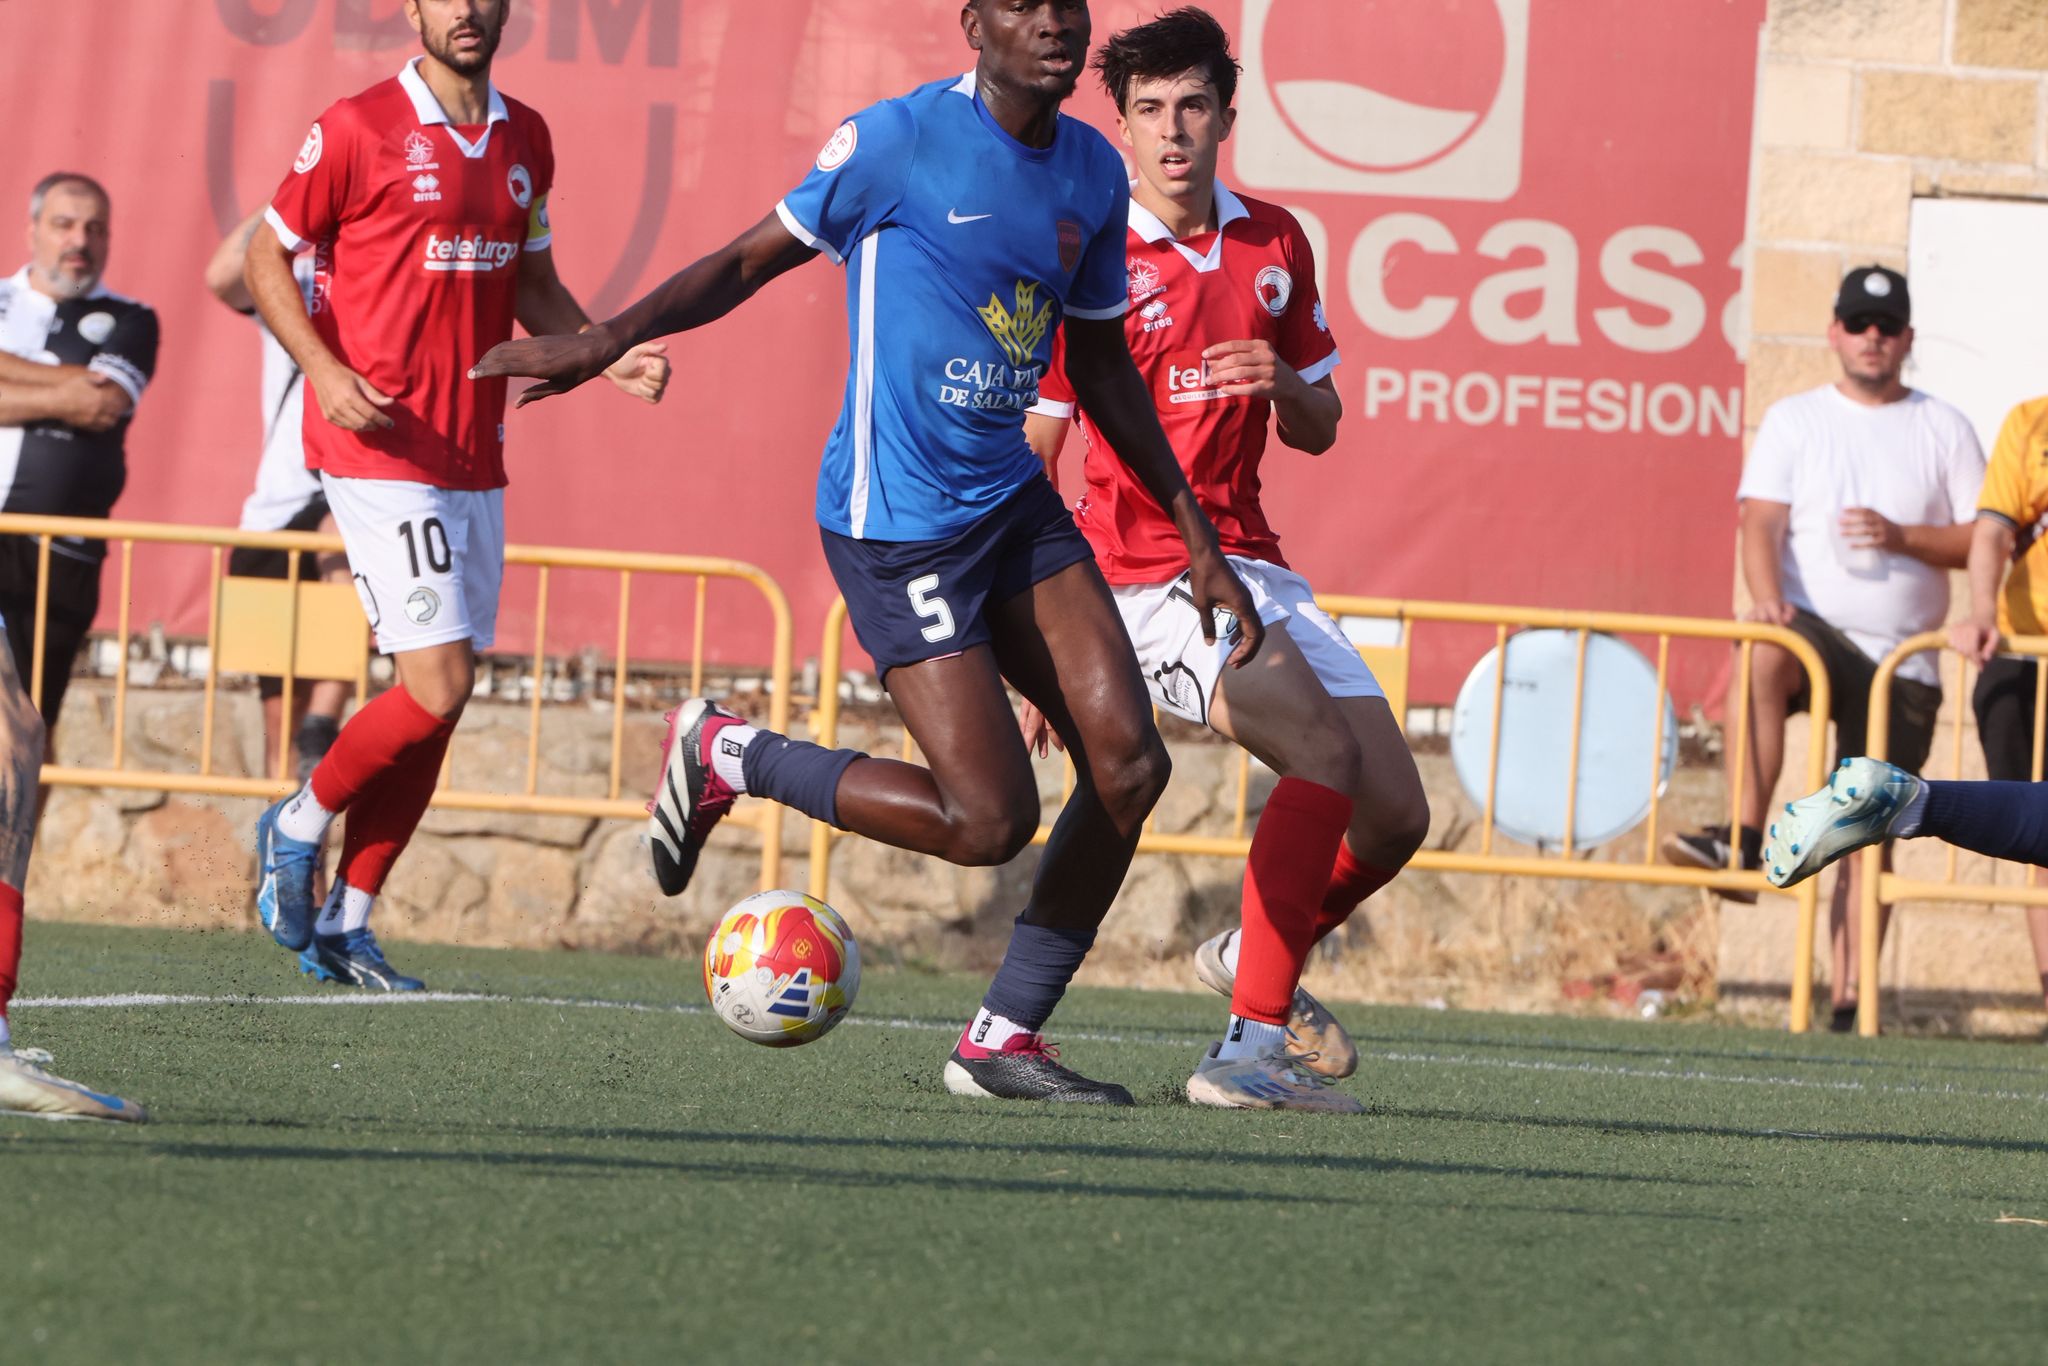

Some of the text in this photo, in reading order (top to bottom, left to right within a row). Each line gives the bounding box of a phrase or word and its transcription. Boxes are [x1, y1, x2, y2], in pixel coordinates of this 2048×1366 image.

[1142, 316, 1174, 333] errea
[944, 358, 1005, 391] CAJA
[939, 385, 969, 407] DE
[398, 517, 452, 578] 10
[907, 573, 956, 643] 5
[723, 741, 741, 756] FS
